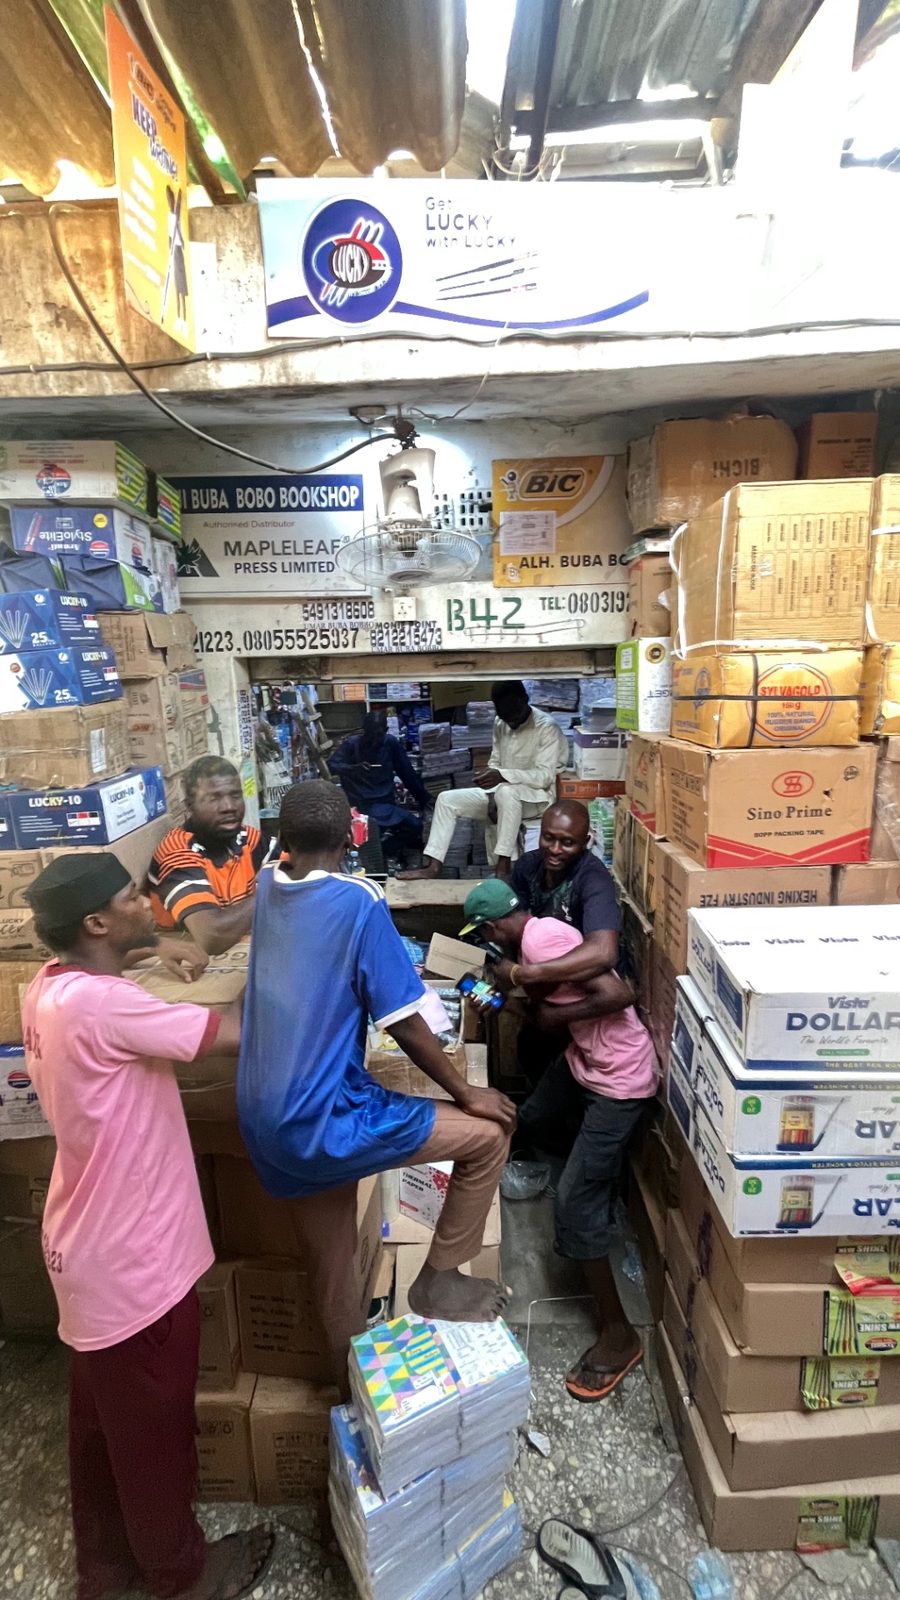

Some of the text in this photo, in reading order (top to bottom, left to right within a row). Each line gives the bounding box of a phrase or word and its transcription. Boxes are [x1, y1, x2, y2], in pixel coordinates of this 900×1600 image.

[425, 213, 493, 231] LUCKY
[464, 236, 517, 248] LUCKY
[331, 243, 371, 284] LUCKY
[190, 488, 229, 509] BUBA
[235, 486, 276, 509] BOBO
[279, 485, 360, 509] BOOKSHOP
[250, 520, 296, 529] Distributor
[39, 529, 92, 541] StyloElite
[223, 539, 341, 557] MAPLELEAF
[234, 561, 336, 574] PRESS LIMITED
[519, 556, 555, 569] ALH.
[560, 554, 603, 568] BUBA
[303, 601, 375, 621] 5491318608
[539, 597, 566, 611] TEL:
[446, 596, 525, 632] B42
[31, 631, 48, 644] 25
[54, 689, 70, 701] 25
[760, 685, 821, 698] SYLVAGOLD
[28, 795, 82, 808] LUCKY-10
[746, 806, 833, 821] Sino Prime
[699, 890, 818, 907] HEXING INDUSTRY FZE
[828, 996, 870, 1009] Vista
[854, 1120, 900, 1139] AR
[402, 1172, 433, 1190] THERMAL
[402, 1179, 424, 1192] PAPER
